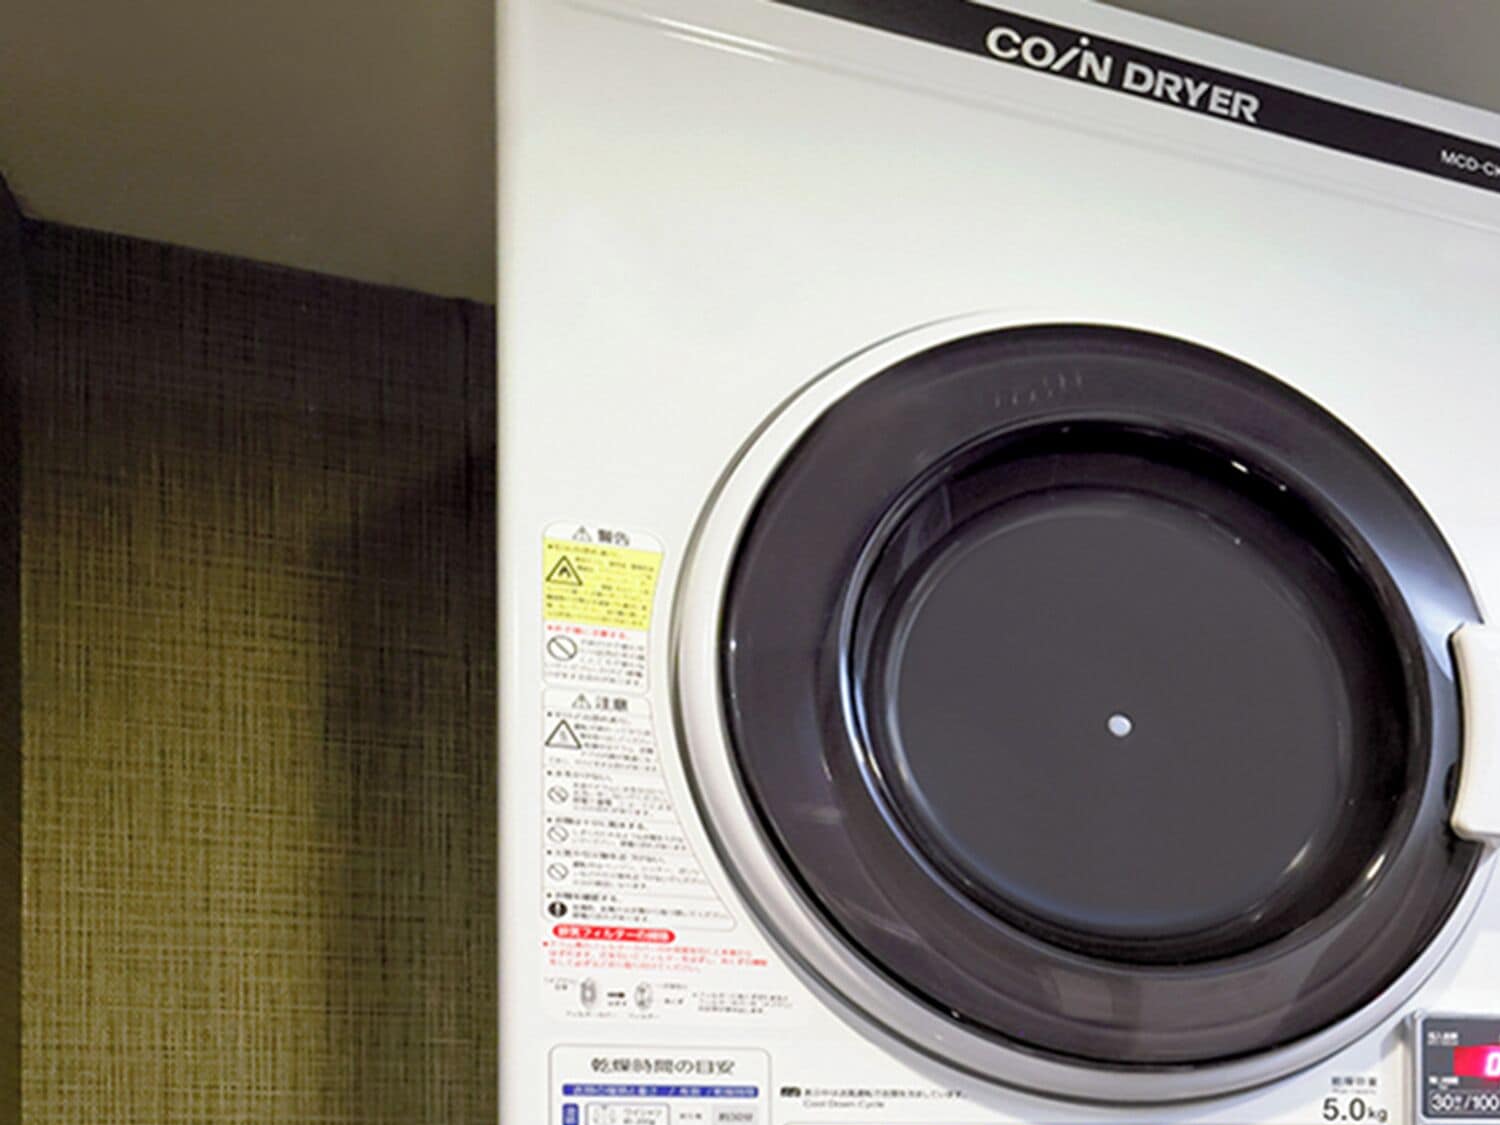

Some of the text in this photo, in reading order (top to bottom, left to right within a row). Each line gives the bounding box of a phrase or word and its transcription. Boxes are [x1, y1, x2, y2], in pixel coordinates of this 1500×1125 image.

[1122, 60, 1260, 125] DRYER
[591, 1057, 735, 1075] 乾燥時間の目安
